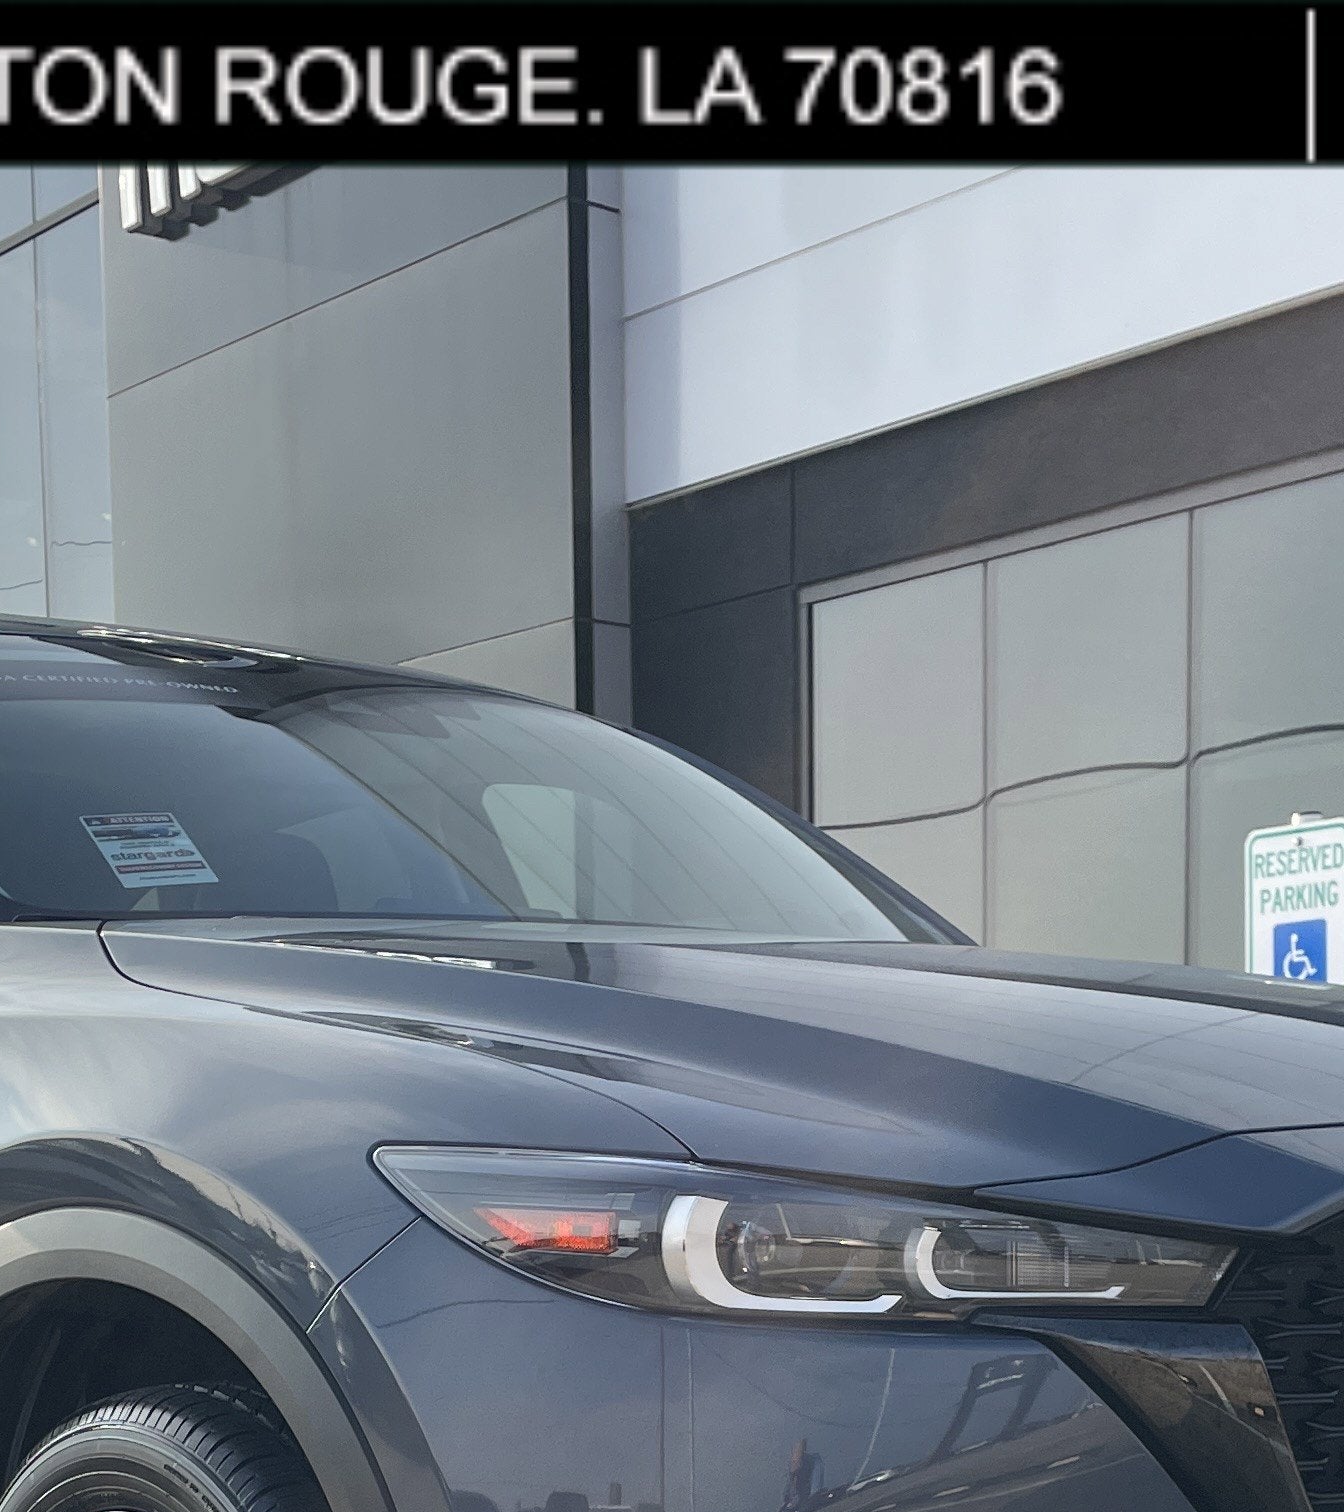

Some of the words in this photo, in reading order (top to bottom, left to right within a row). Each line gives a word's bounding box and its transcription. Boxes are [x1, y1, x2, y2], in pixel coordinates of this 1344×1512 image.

[22, 674, 119, 687] CERTIFIED
[1255, 843, 1344, 879] RESERVED
[1261, 880, 1338, 913] PARKING
